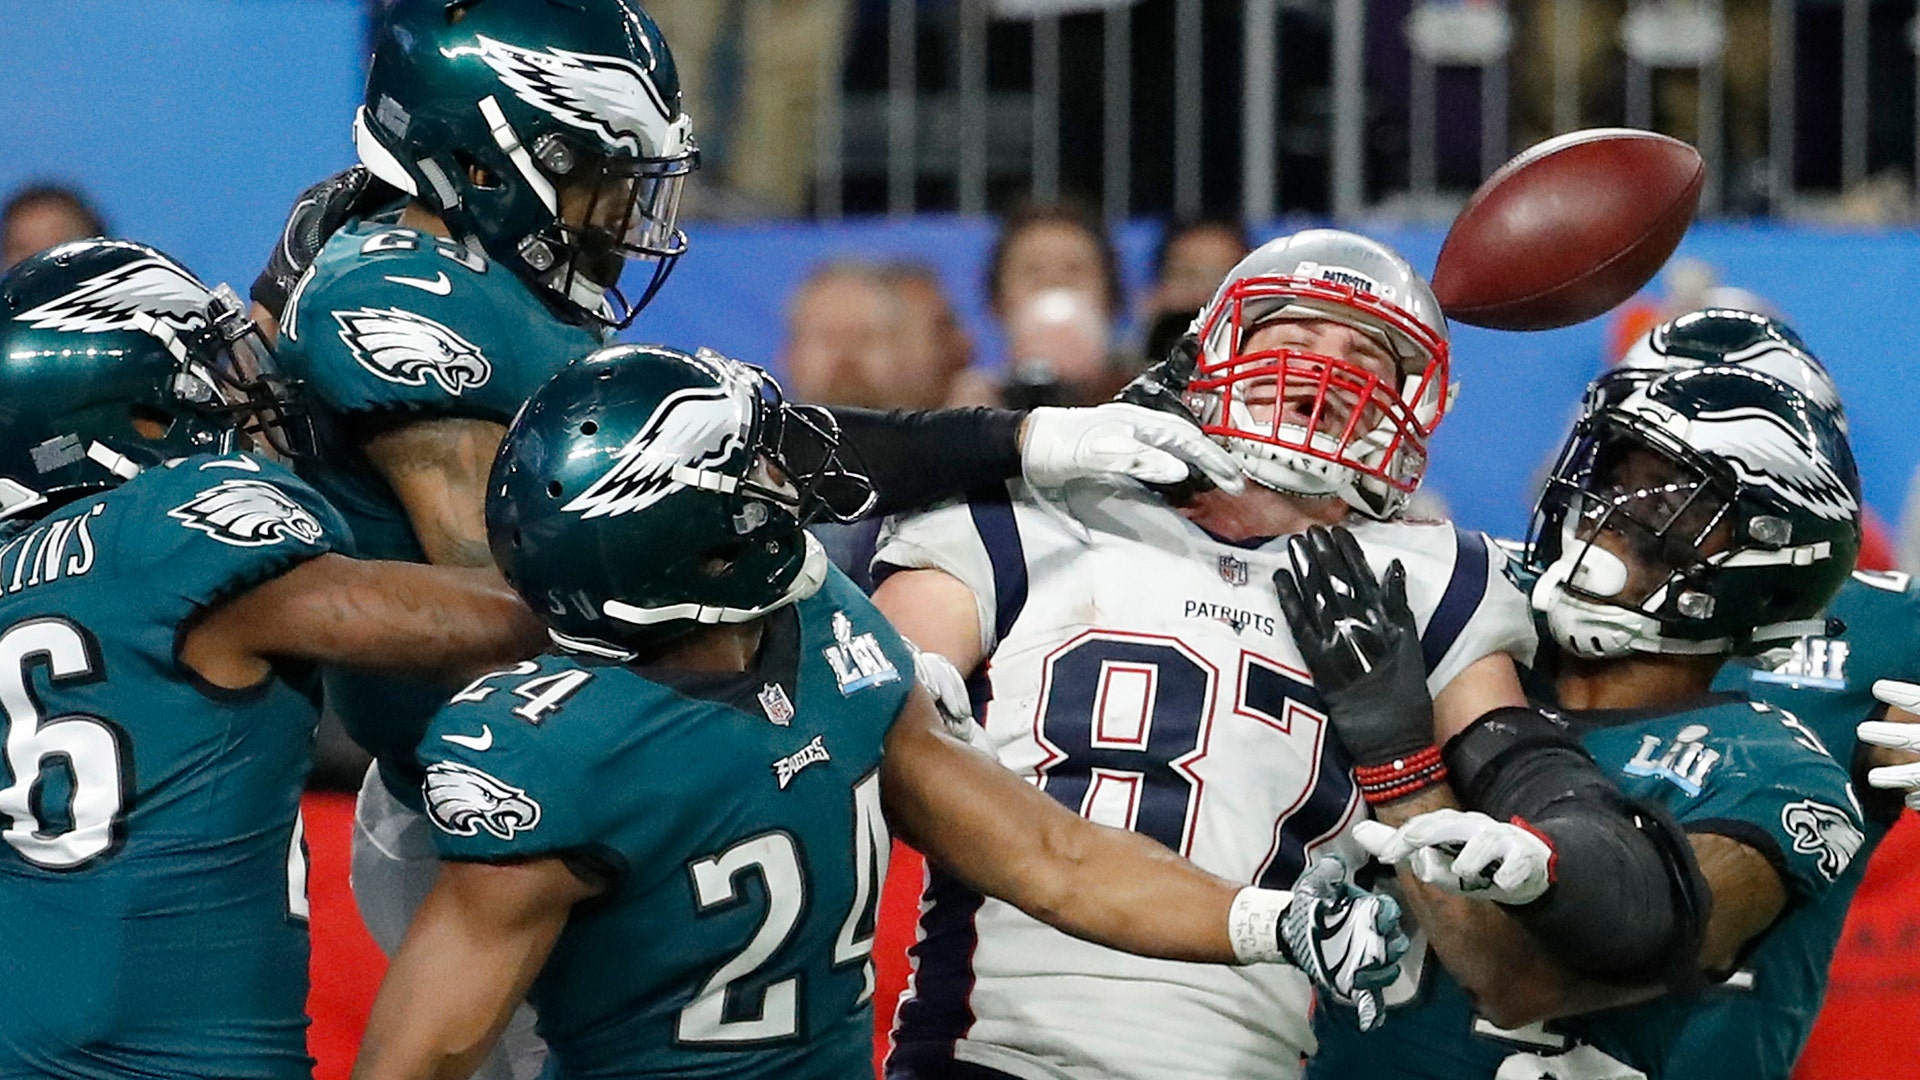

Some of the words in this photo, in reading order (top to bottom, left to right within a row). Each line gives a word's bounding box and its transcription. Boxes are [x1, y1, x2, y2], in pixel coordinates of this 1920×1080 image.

[1322, 270, 1372, 292] PATRIOTS
[0, 502, 106, 597] INS
[1184, 600, 1275, 636] PATRIOTS
[448, 659, 594, 726] 24
[0, 616, 128, 868] 6
[771, 735, 832, 790] EAGLES
[1034, 638, 1360, 889] 87
[677, 767, 891, 1042] 24
